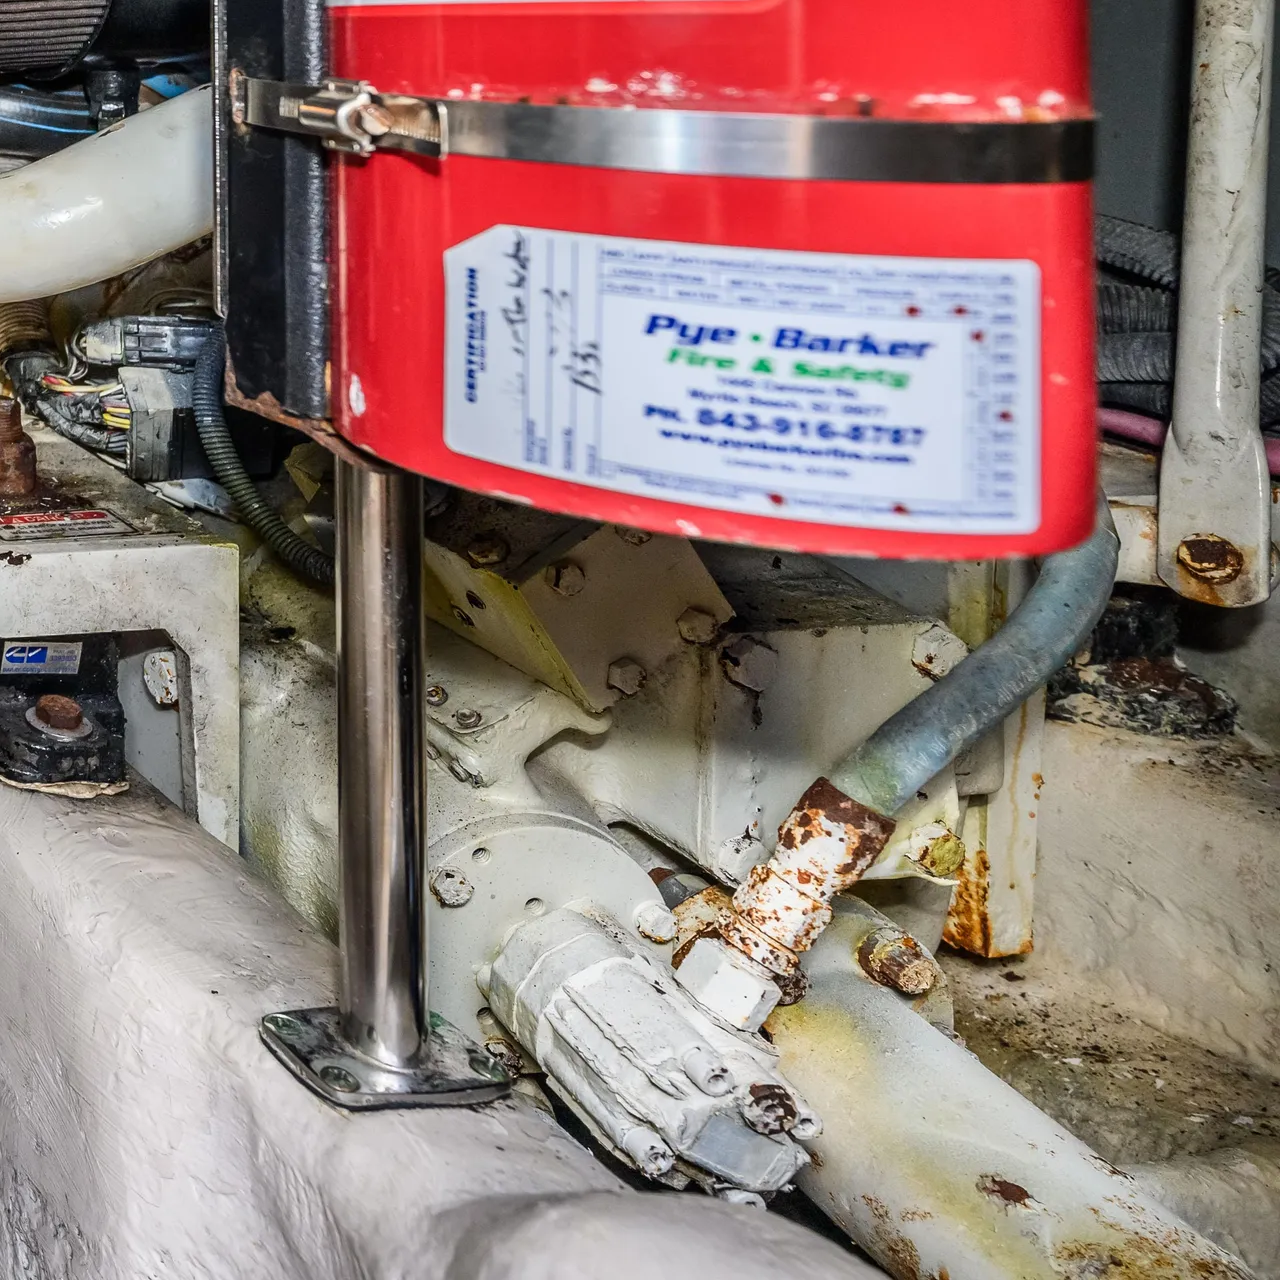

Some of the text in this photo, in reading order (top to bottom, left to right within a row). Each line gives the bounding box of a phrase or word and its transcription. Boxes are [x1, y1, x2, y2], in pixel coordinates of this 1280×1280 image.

[465, 267, 479, 405] CERTIFICATION
[644, 314, 933, 359] Pye Barker
[667, 347, 737, 370] Fire
[792, 361, 910, 389] Safety
